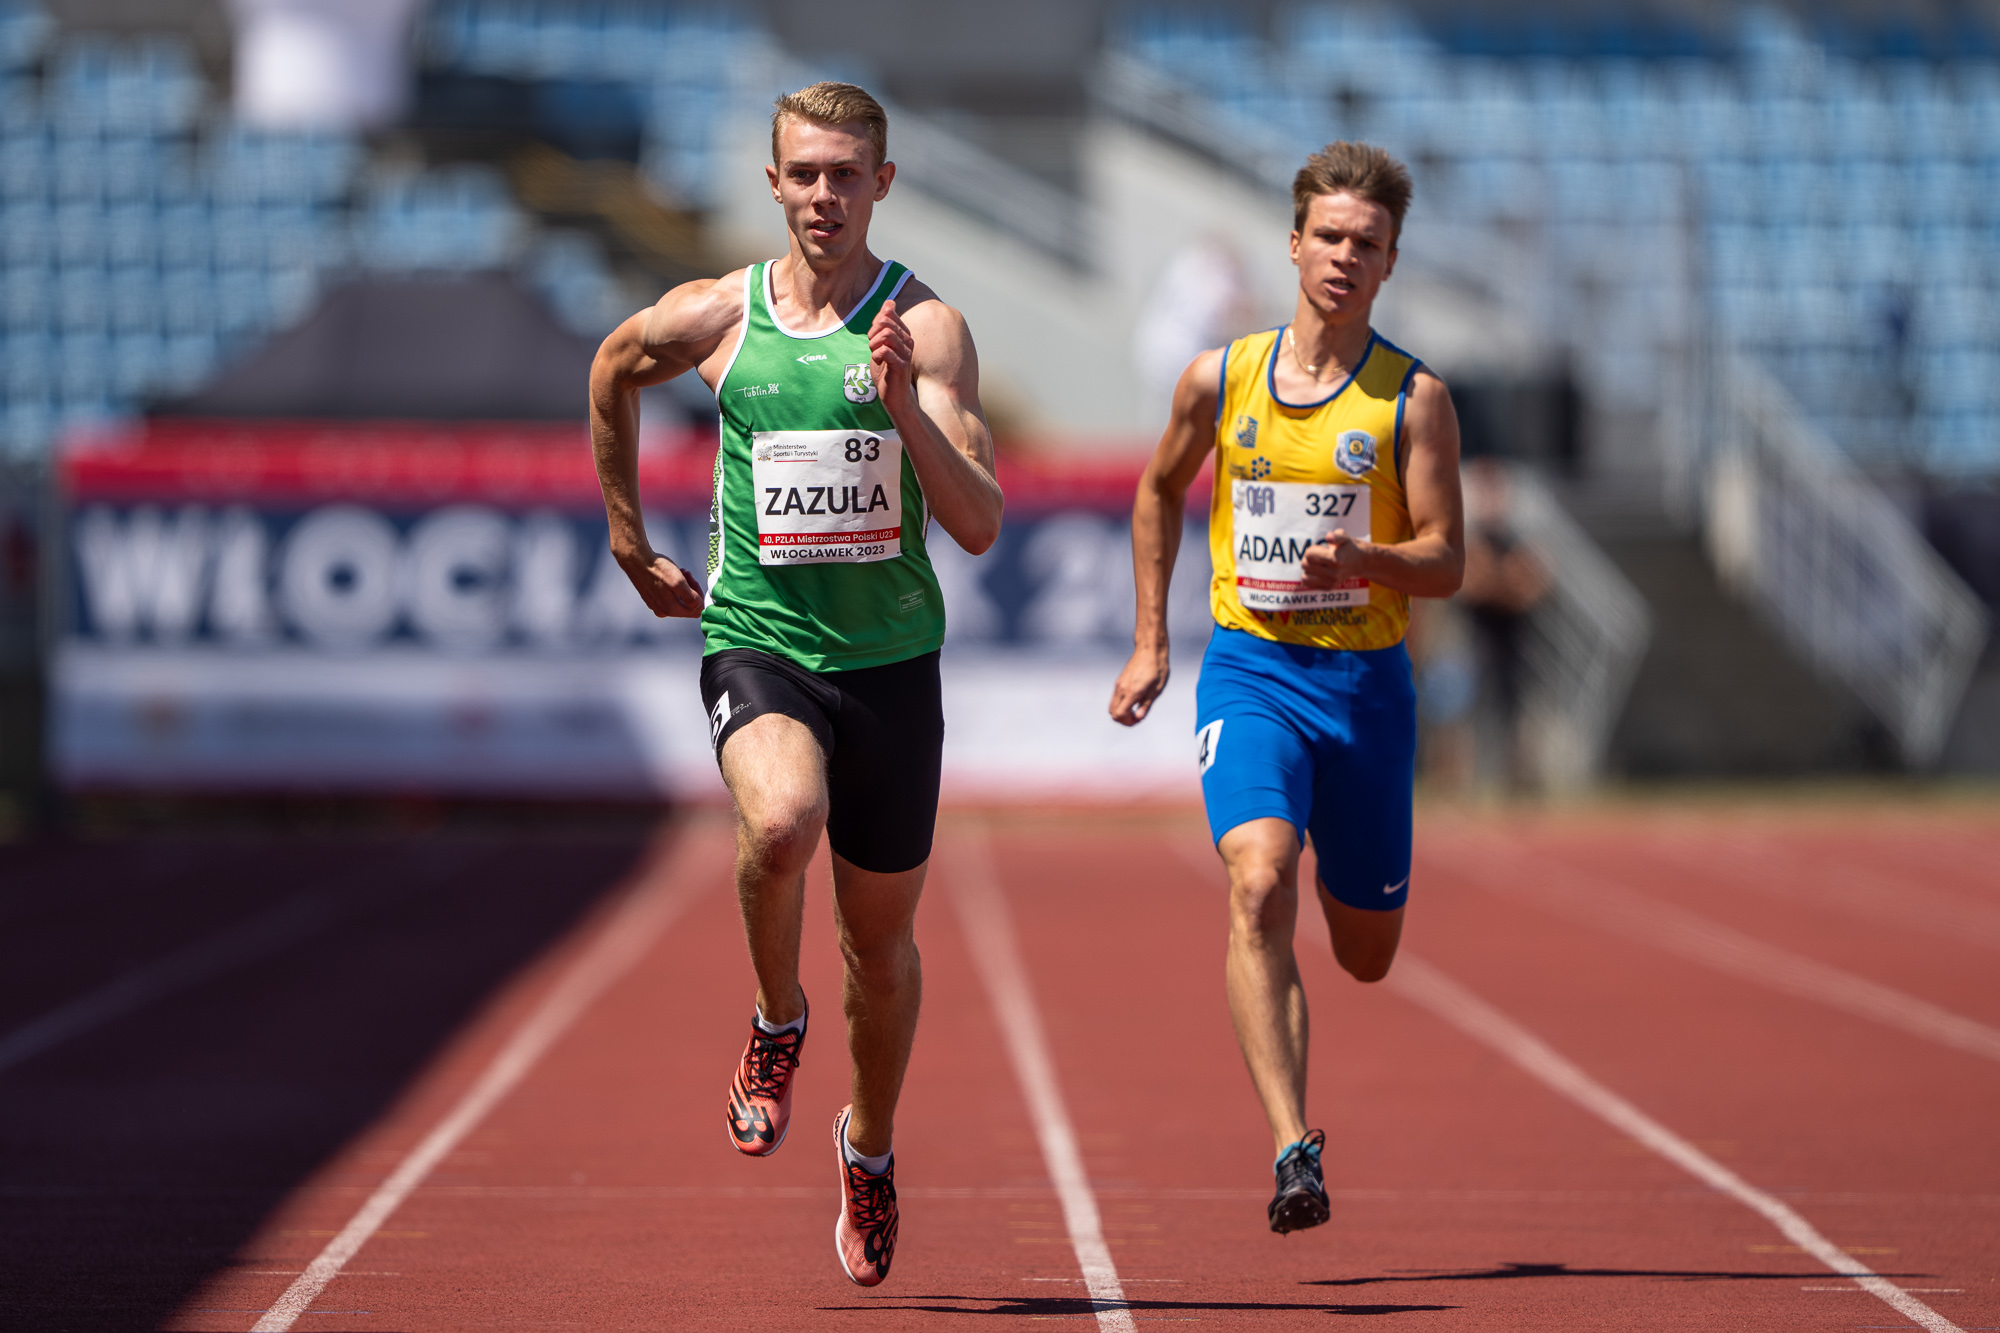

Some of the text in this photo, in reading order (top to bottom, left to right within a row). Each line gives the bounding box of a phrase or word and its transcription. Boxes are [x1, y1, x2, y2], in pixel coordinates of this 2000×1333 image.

[845, 437, 880, 463] 83
[765, 484, 889, 515] ZAZULA
[1305, 493, 1357, 517] 327
[763, 530, 894, 544] 40. PZLA Mistrzostwa Polski U23
[1239, 534, 1329, 563] ADAM
[770, 545, 885, 559] WŁOCŁAWEK 2023
[1249, 591, 1350, 604] WŁOCŁAWEK 2023
[1200, 728, 1209, 767] 4
